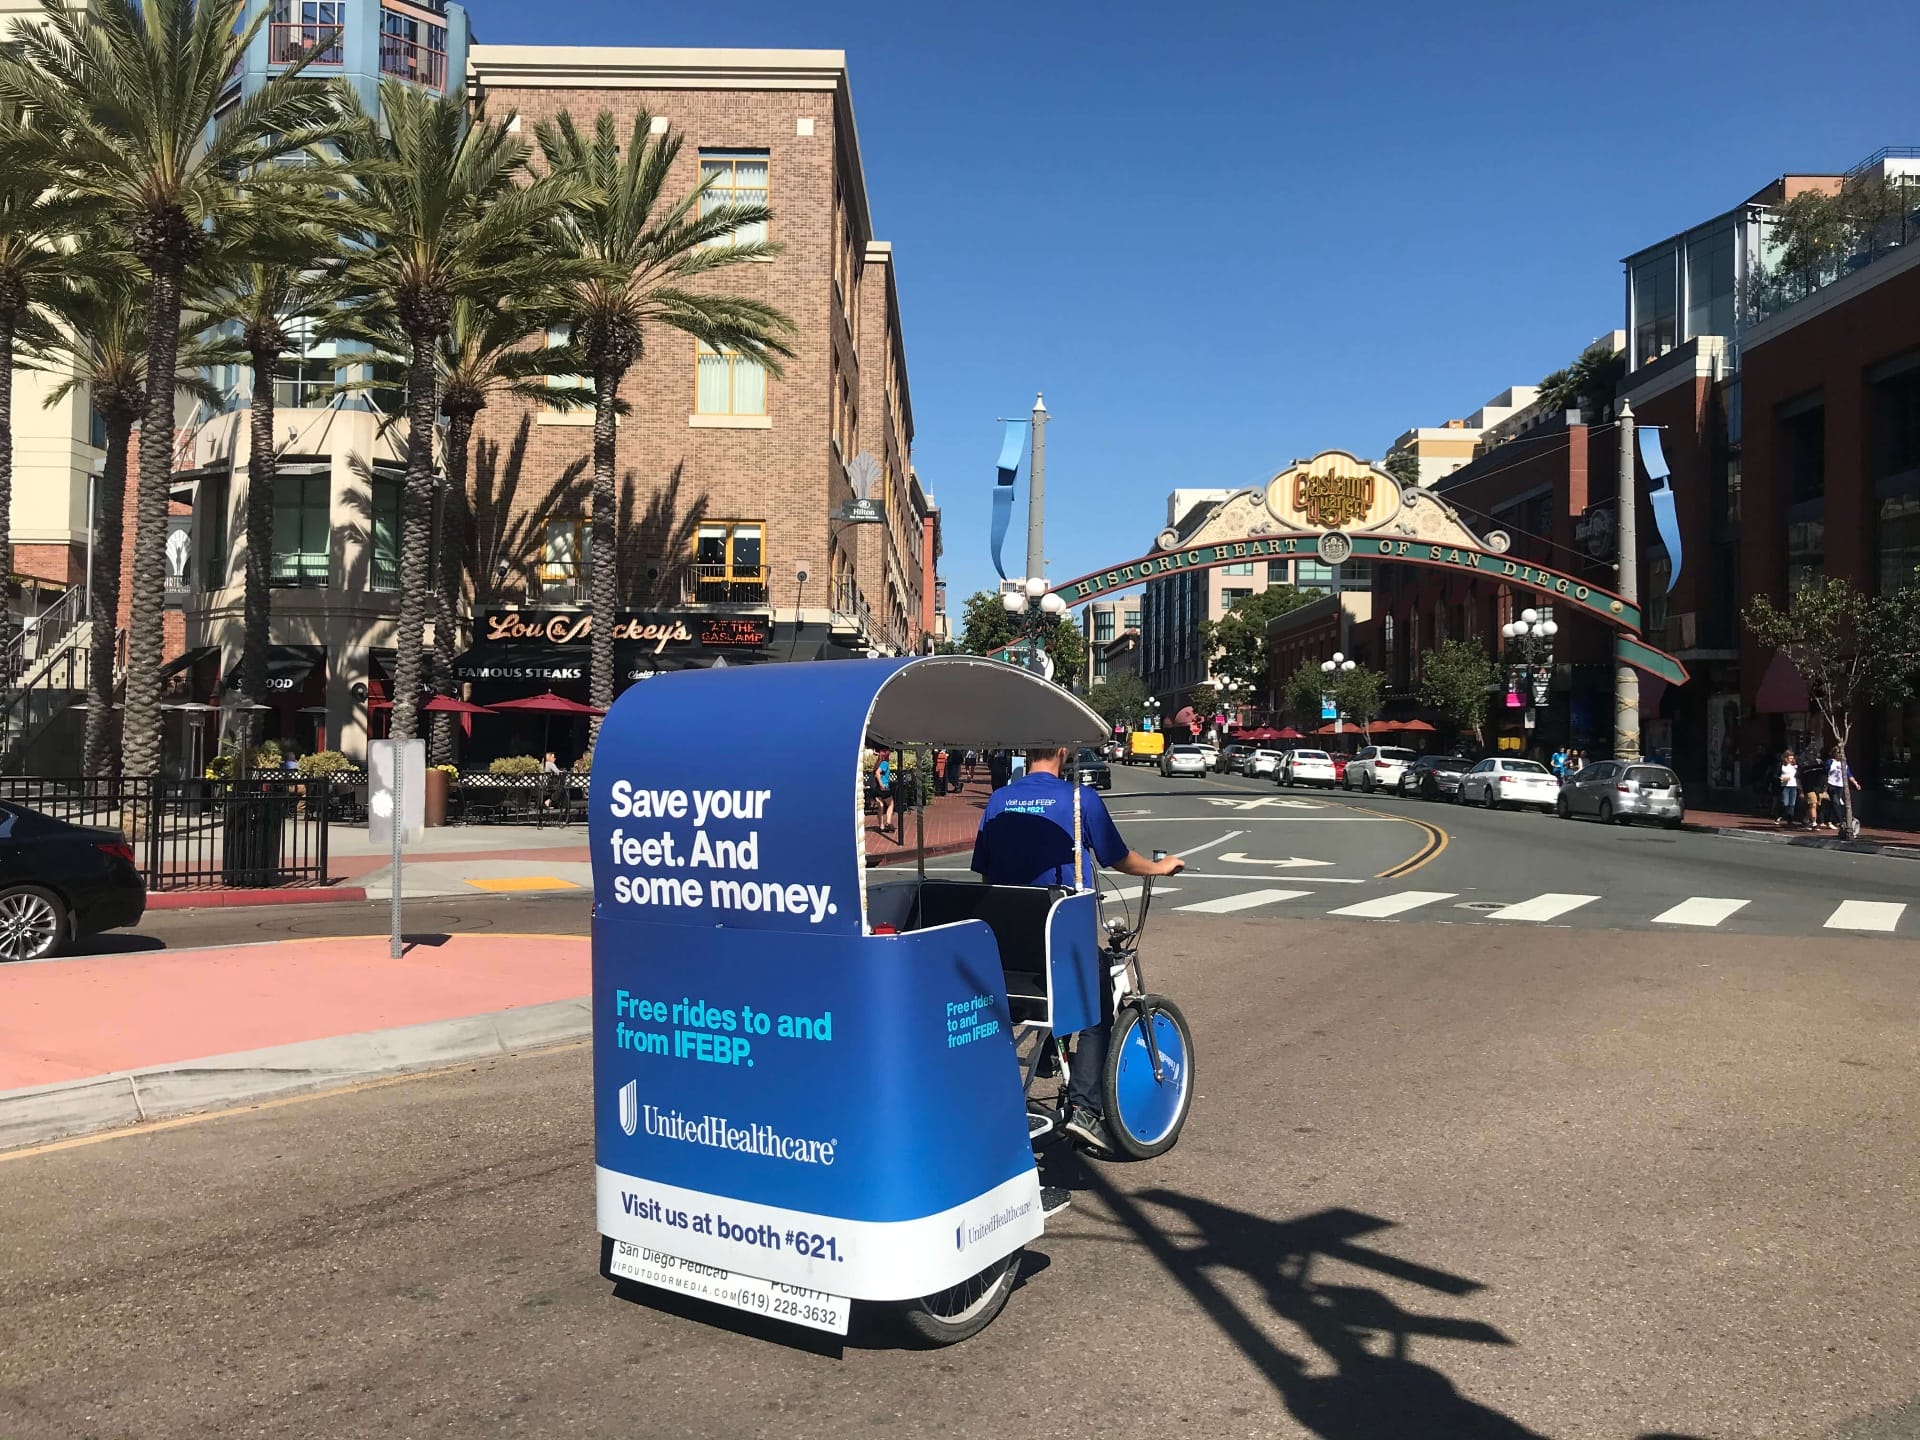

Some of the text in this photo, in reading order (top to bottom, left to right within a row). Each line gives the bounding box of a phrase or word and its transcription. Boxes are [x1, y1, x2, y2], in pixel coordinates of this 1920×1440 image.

[1294, 467, 1375, 508] Gaslamp
[853, 508, 875, 516] Hilton
[1307, 494, 1367, 527] Quarter
[1075, 539, 1590, 601] HISTORIC HEART OF SAN DIEGO
[486, 613, 545, 641] Lou
[546, 613, 693, 655] Mckey's
[701, 632, 764, 642] GASLAMP
[711, 623, 755, 632] AT THE
[236, 678, 294, 689] SOOD
[458, 667, 582, 679] FAMOUS STEAKS
[610, 779, 771, 827] Save your
[610, 828, 758, 870] feet. And
[614, 875, 838, 924] some money.
[616, 989, 832, 1041] Free rides to and
[946, 994, 994, 1017] Free rides
[946, 1010, 978, 1032] to and
[616, 1021, 754, 1067] from IFEBP.
[947, 1020, 1000, 1049] from IFEBP.
[621, 1191, 844, 1263] Visit us at booth #621.
[618, 1241, 639, 1258] San
[642, 1247, 676, 1269] Diego
[737, 1288, 837, 1326] (619) 228-3632
